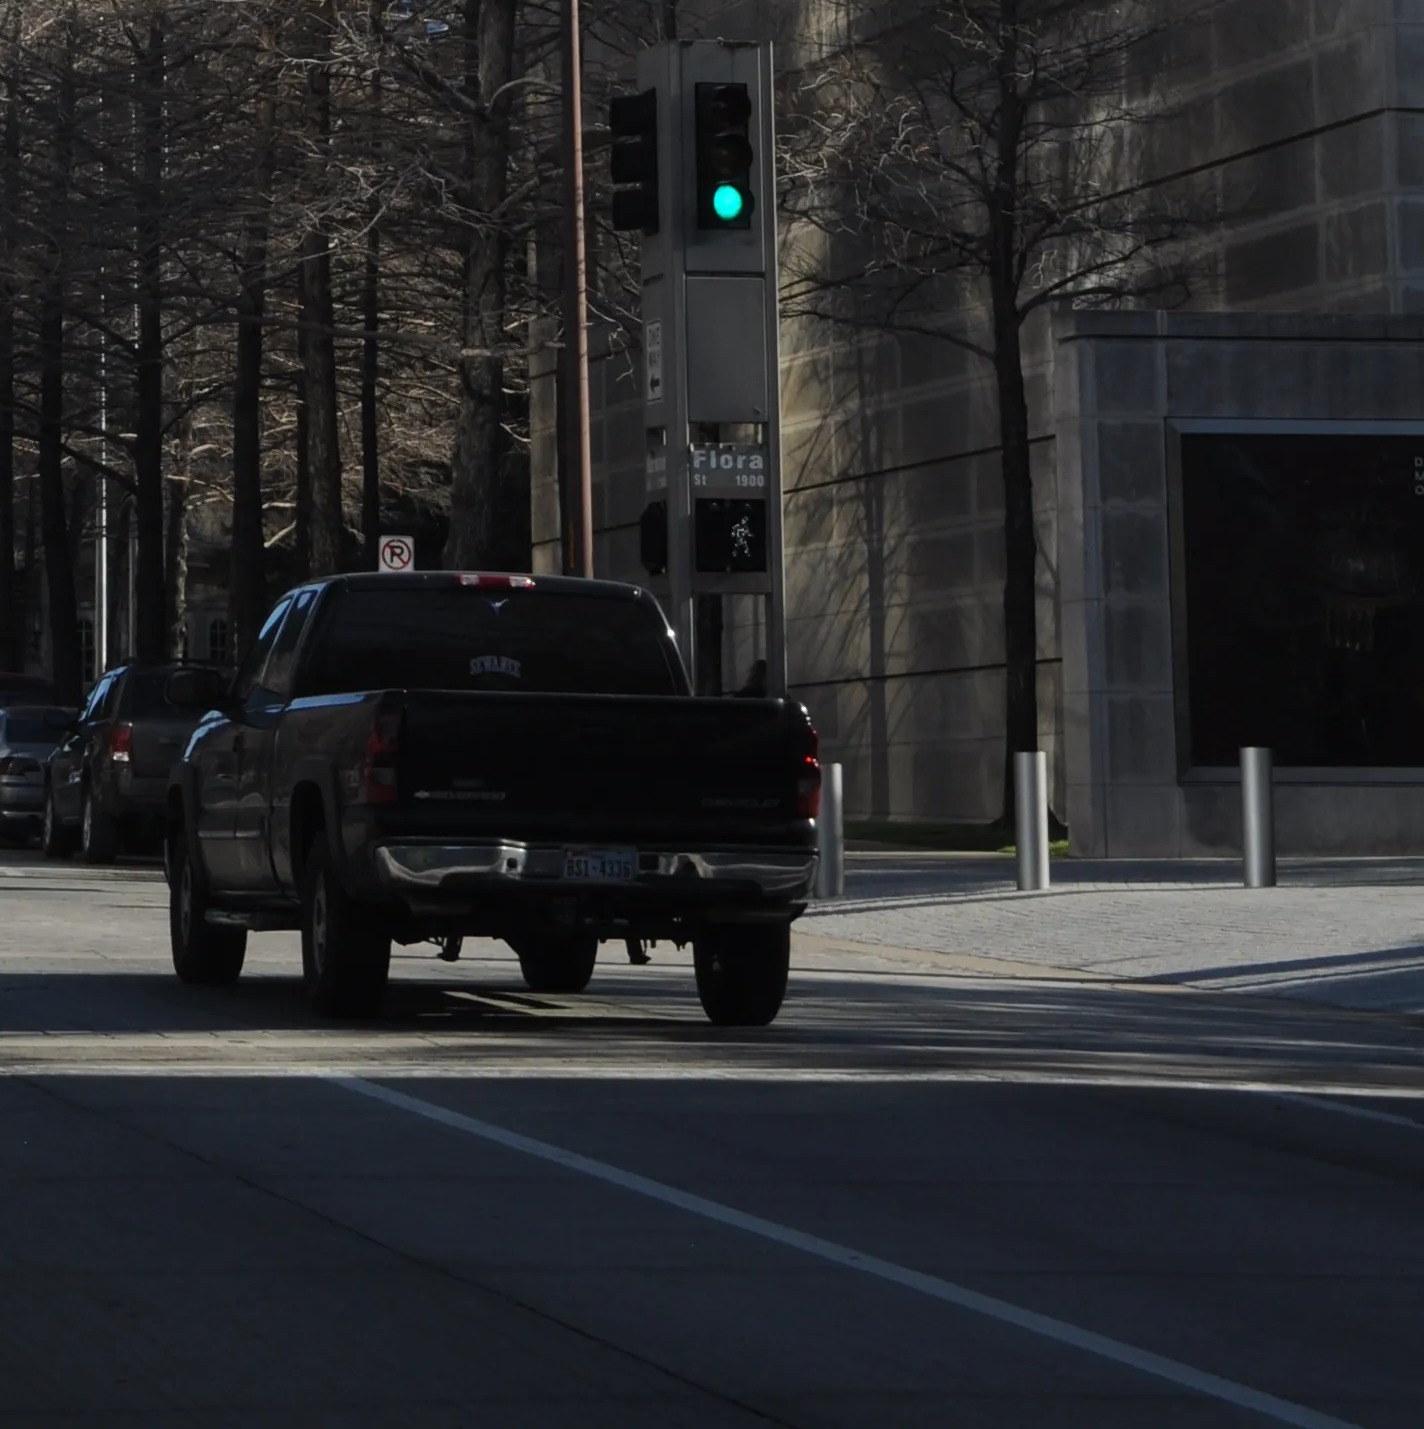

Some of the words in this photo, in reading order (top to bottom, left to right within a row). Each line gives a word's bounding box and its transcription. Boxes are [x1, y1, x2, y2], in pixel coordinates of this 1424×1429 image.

[693, 450, 764, 470] Flora
[693, 474, 708, 486] St
[735, 474, 765, 487] 1900
